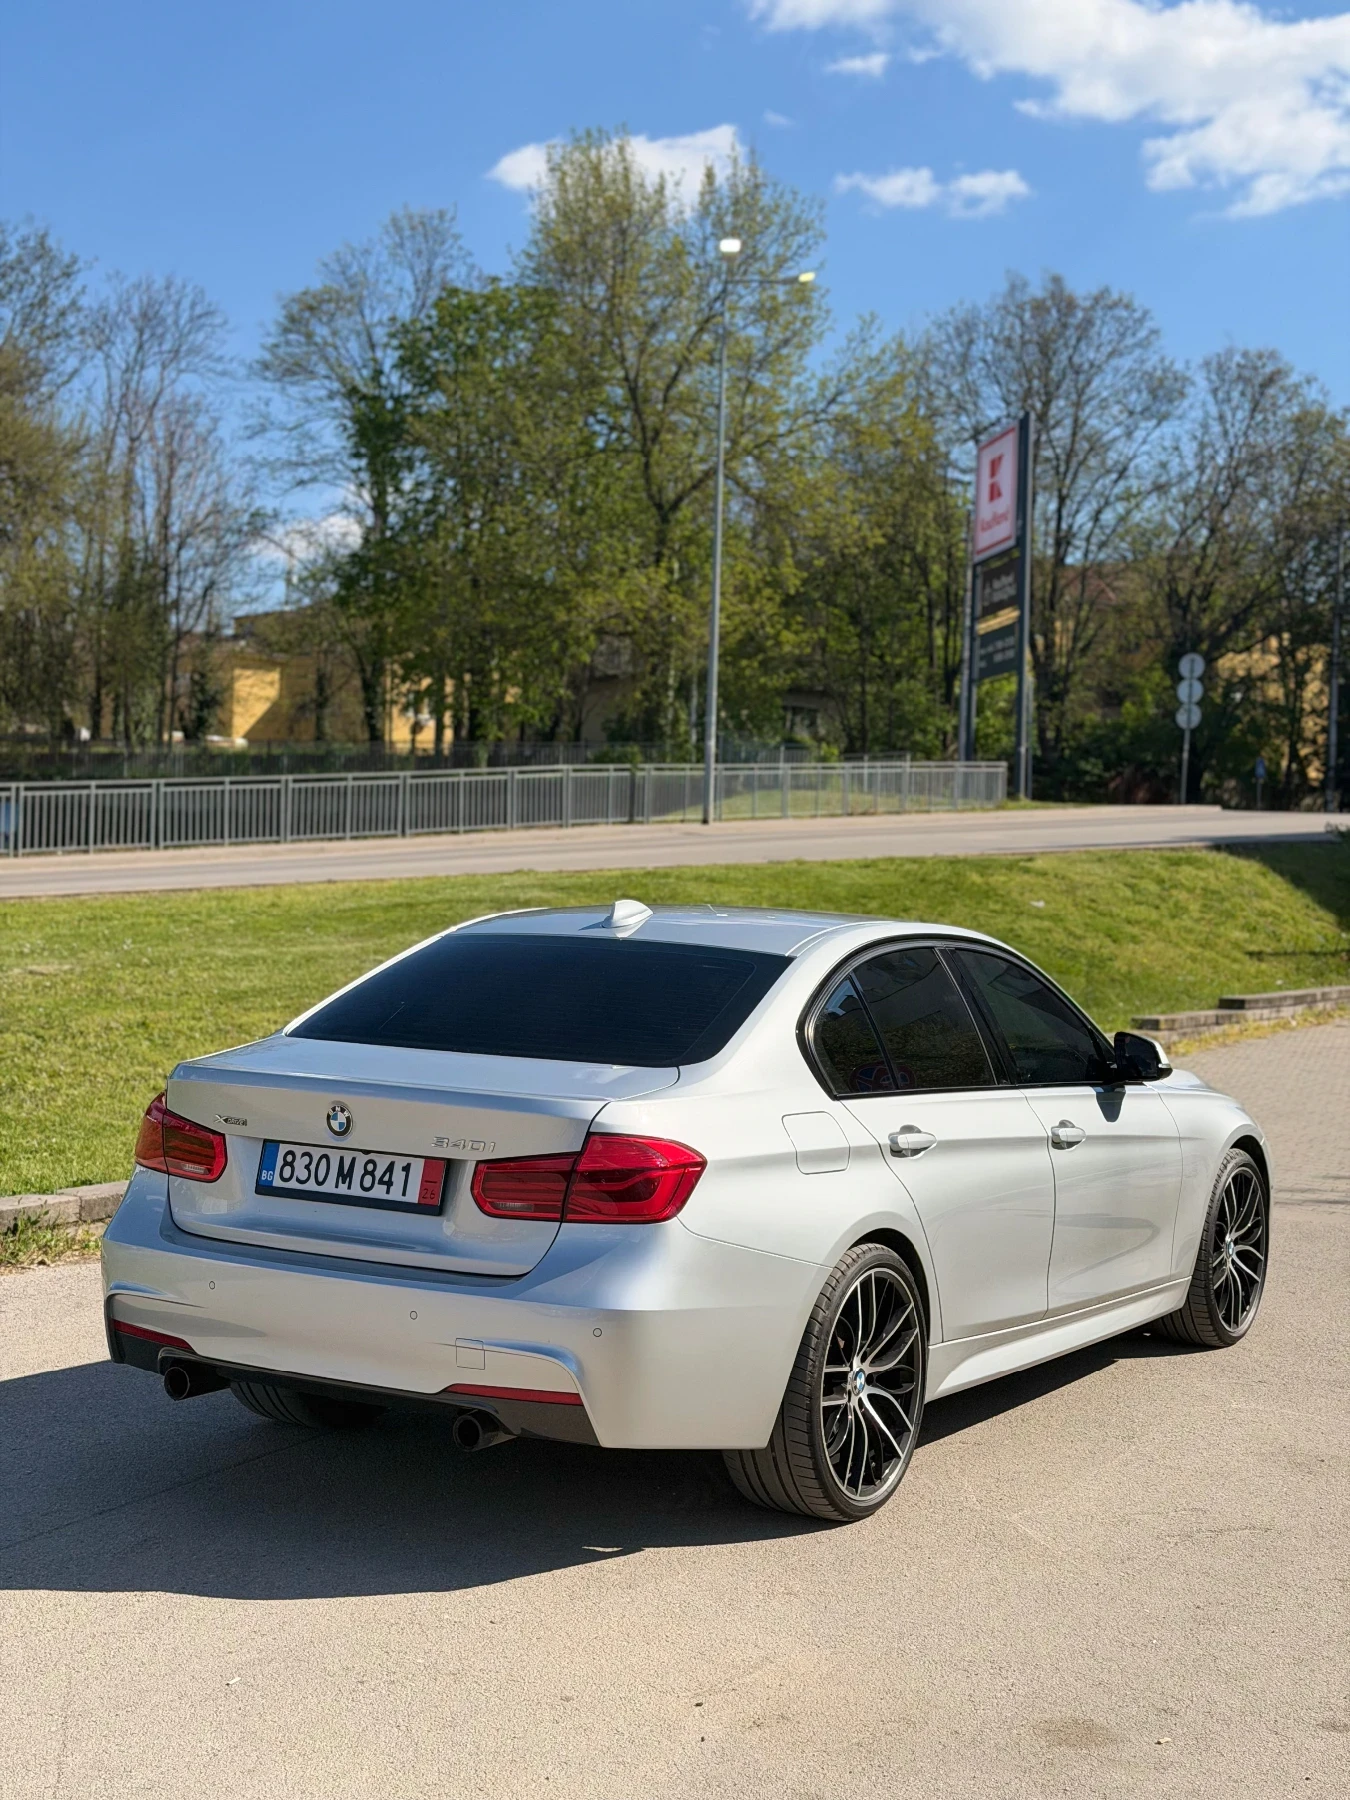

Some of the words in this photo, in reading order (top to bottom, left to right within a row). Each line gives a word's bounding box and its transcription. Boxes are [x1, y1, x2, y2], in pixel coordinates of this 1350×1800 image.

[261, 1169, 274, 1181] BG
[279, 1149, 331, 1187] 830
[334, 1155, 357, 1190] M
[359, 1158, 412, 1197] 841
[421, 1188, 436, 1200] 26
